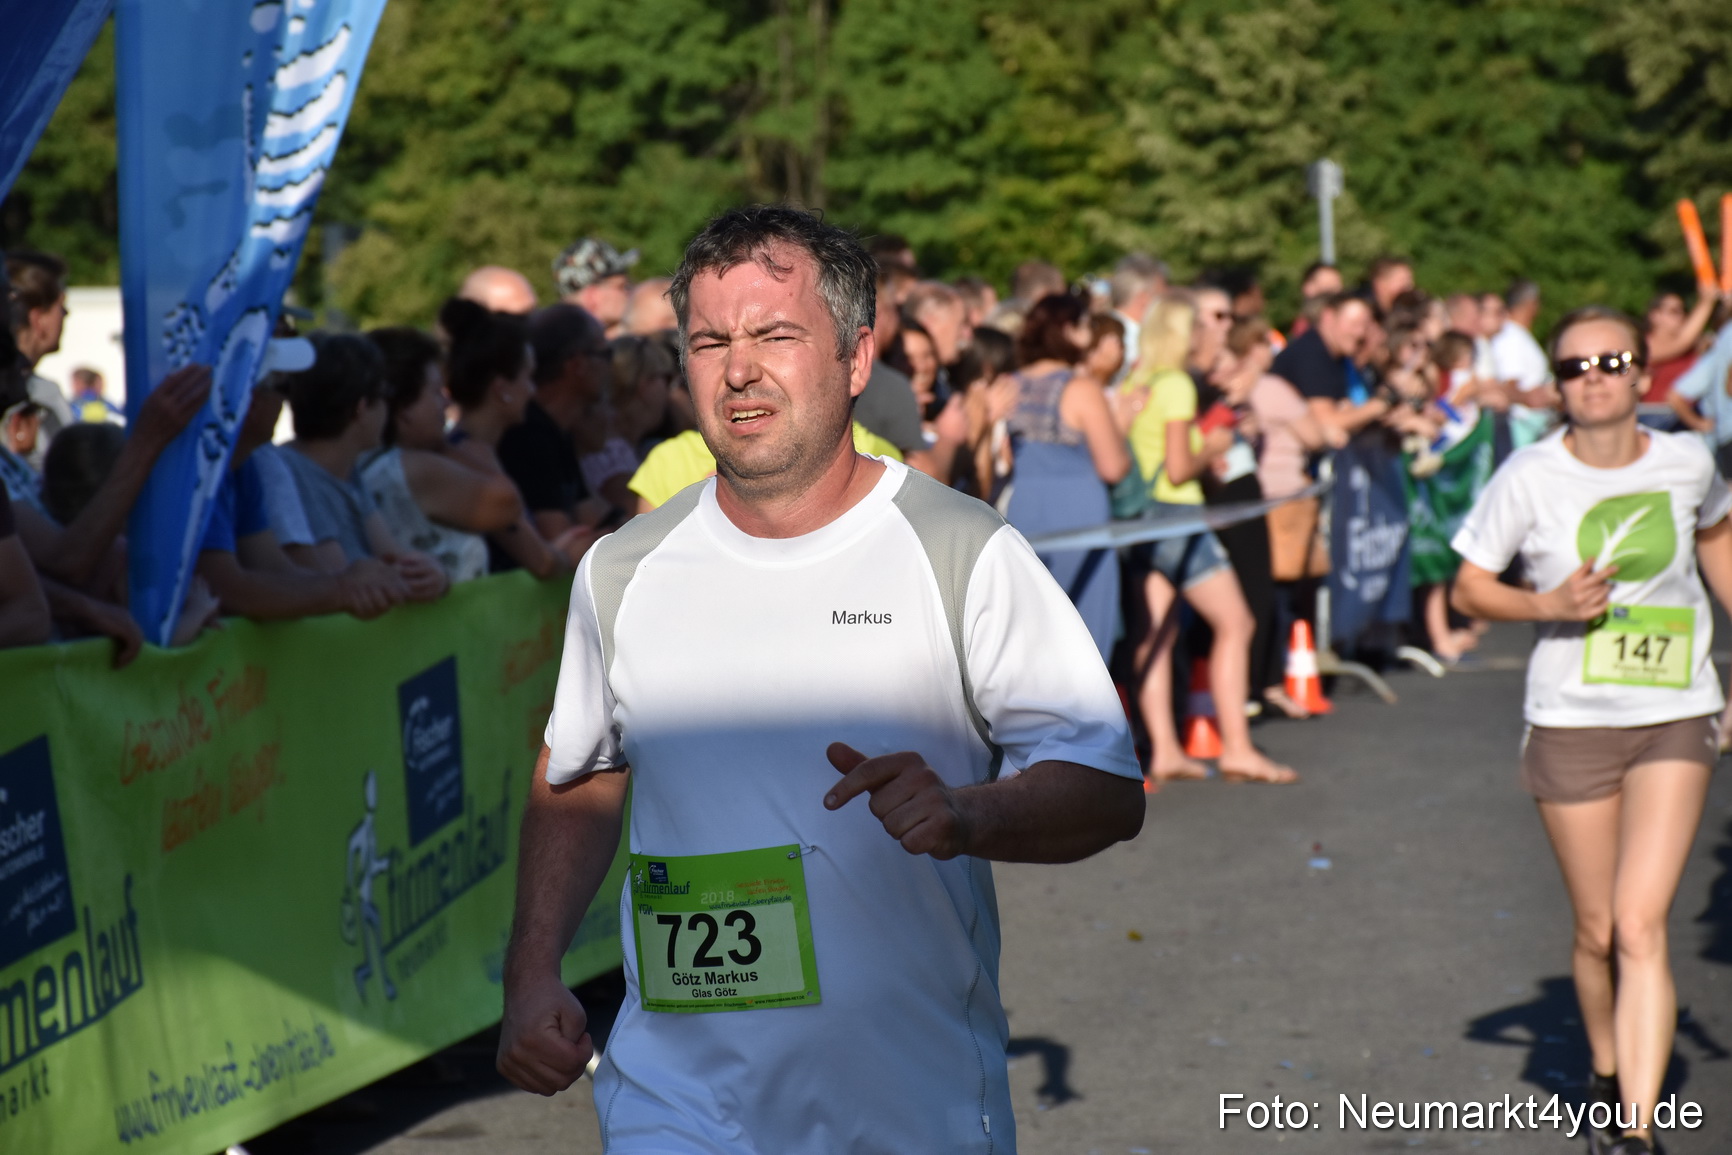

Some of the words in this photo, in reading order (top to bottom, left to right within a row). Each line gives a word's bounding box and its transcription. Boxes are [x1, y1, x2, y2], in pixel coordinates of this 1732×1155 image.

[832, 610, 892, 625] Markus
[1613, 633, 1673, 664] 147
[643, 880, 691, 895] firmenlauf
[701, 890, 735, 905] 2018
[656, 909, 762, 969] 723
[671, 971, 701, 986] Götz
[704, 970, 759, 985] Markus
[692, 988, 712, 998] Glas
[714, 987, 738, 997] Götz
